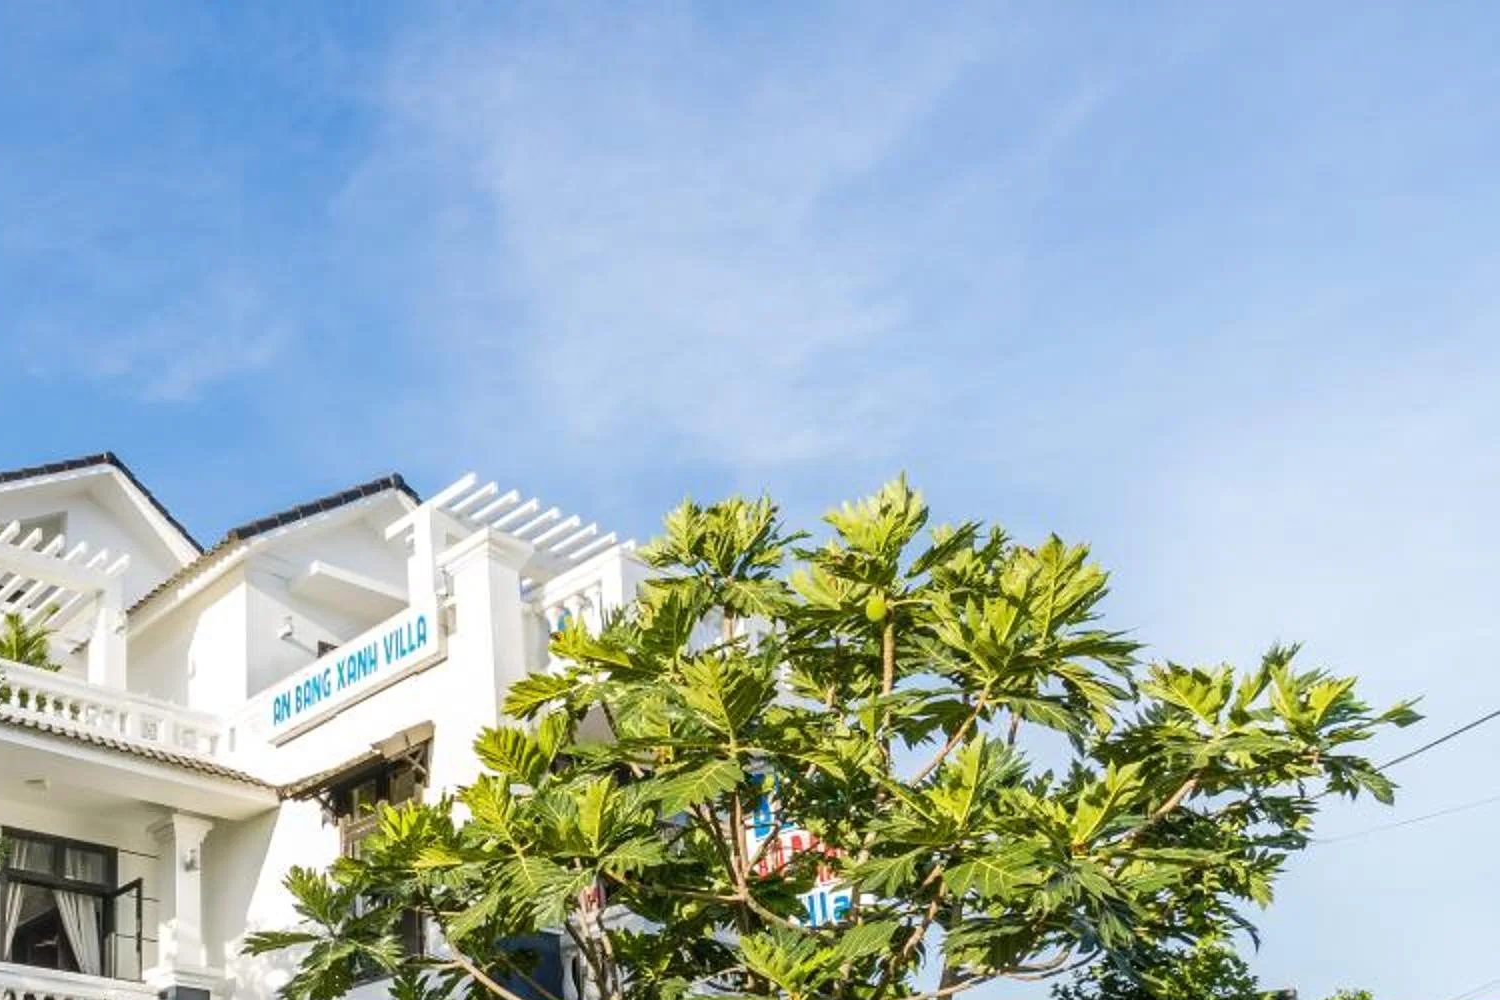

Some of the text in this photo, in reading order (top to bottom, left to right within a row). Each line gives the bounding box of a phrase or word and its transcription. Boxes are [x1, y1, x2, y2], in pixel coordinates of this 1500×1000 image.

[274, 614, 427, 726] AN BANG XANH VILLA
